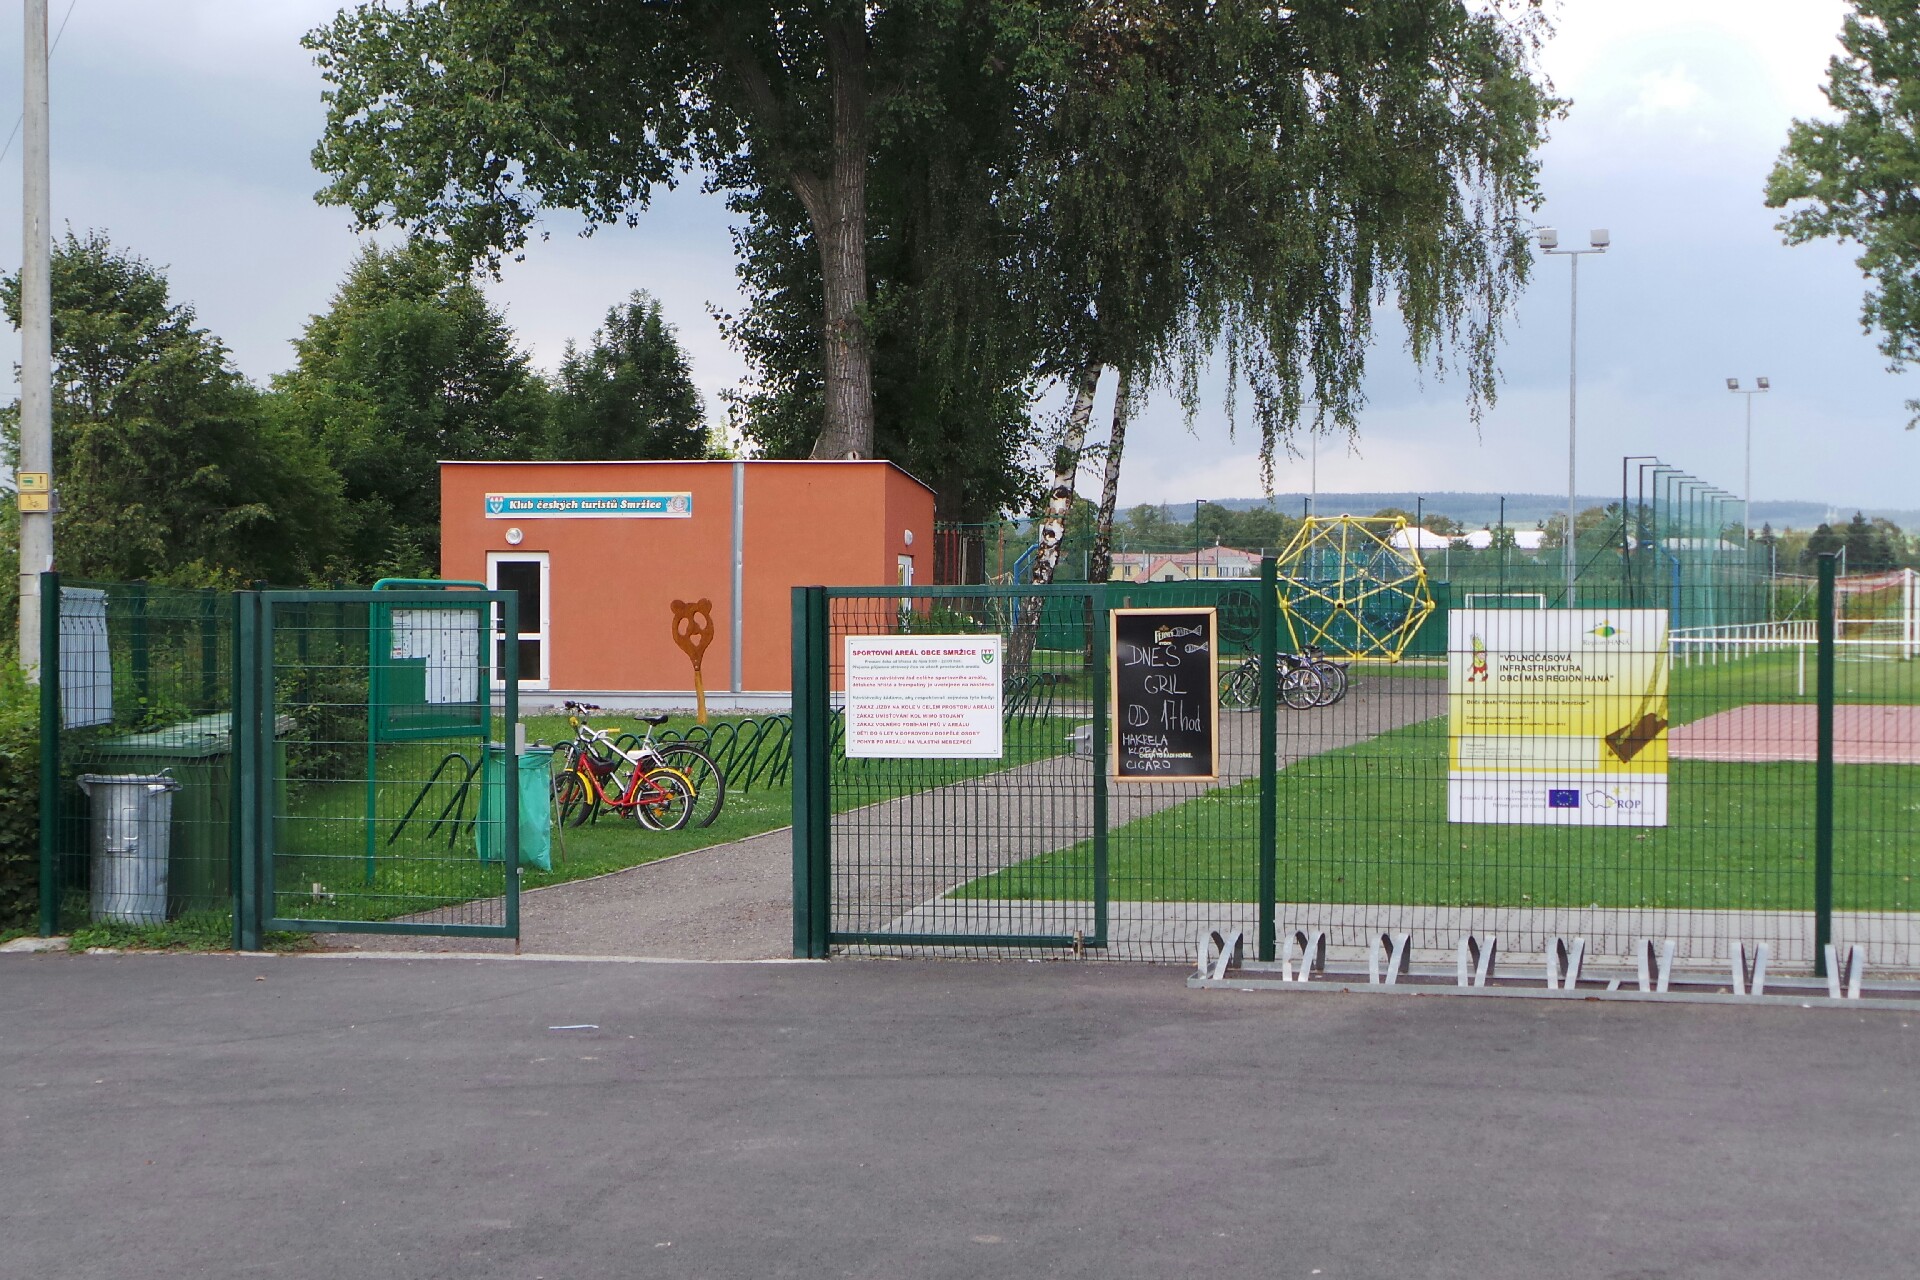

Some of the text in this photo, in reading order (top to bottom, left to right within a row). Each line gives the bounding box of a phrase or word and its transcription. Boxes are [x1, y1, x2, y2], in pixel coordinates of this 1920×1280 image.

[509, 499, 662, 511] Klub českých turistů Smržice
[1124, 645, 1180, 667] DNES
[1500, 664, 1581, 672] INFRASTRUKTURA
[1144, 674, 1187, 694] GRIL
[1500, 674, 1522, 682] OBCÍ
[1525, 674, 1544, 682] MAS
[1546, 674, 1582, 682] REGION
[1128, 704, 1150, 727] OD
[1618, 800, 1641, 809] ROP
